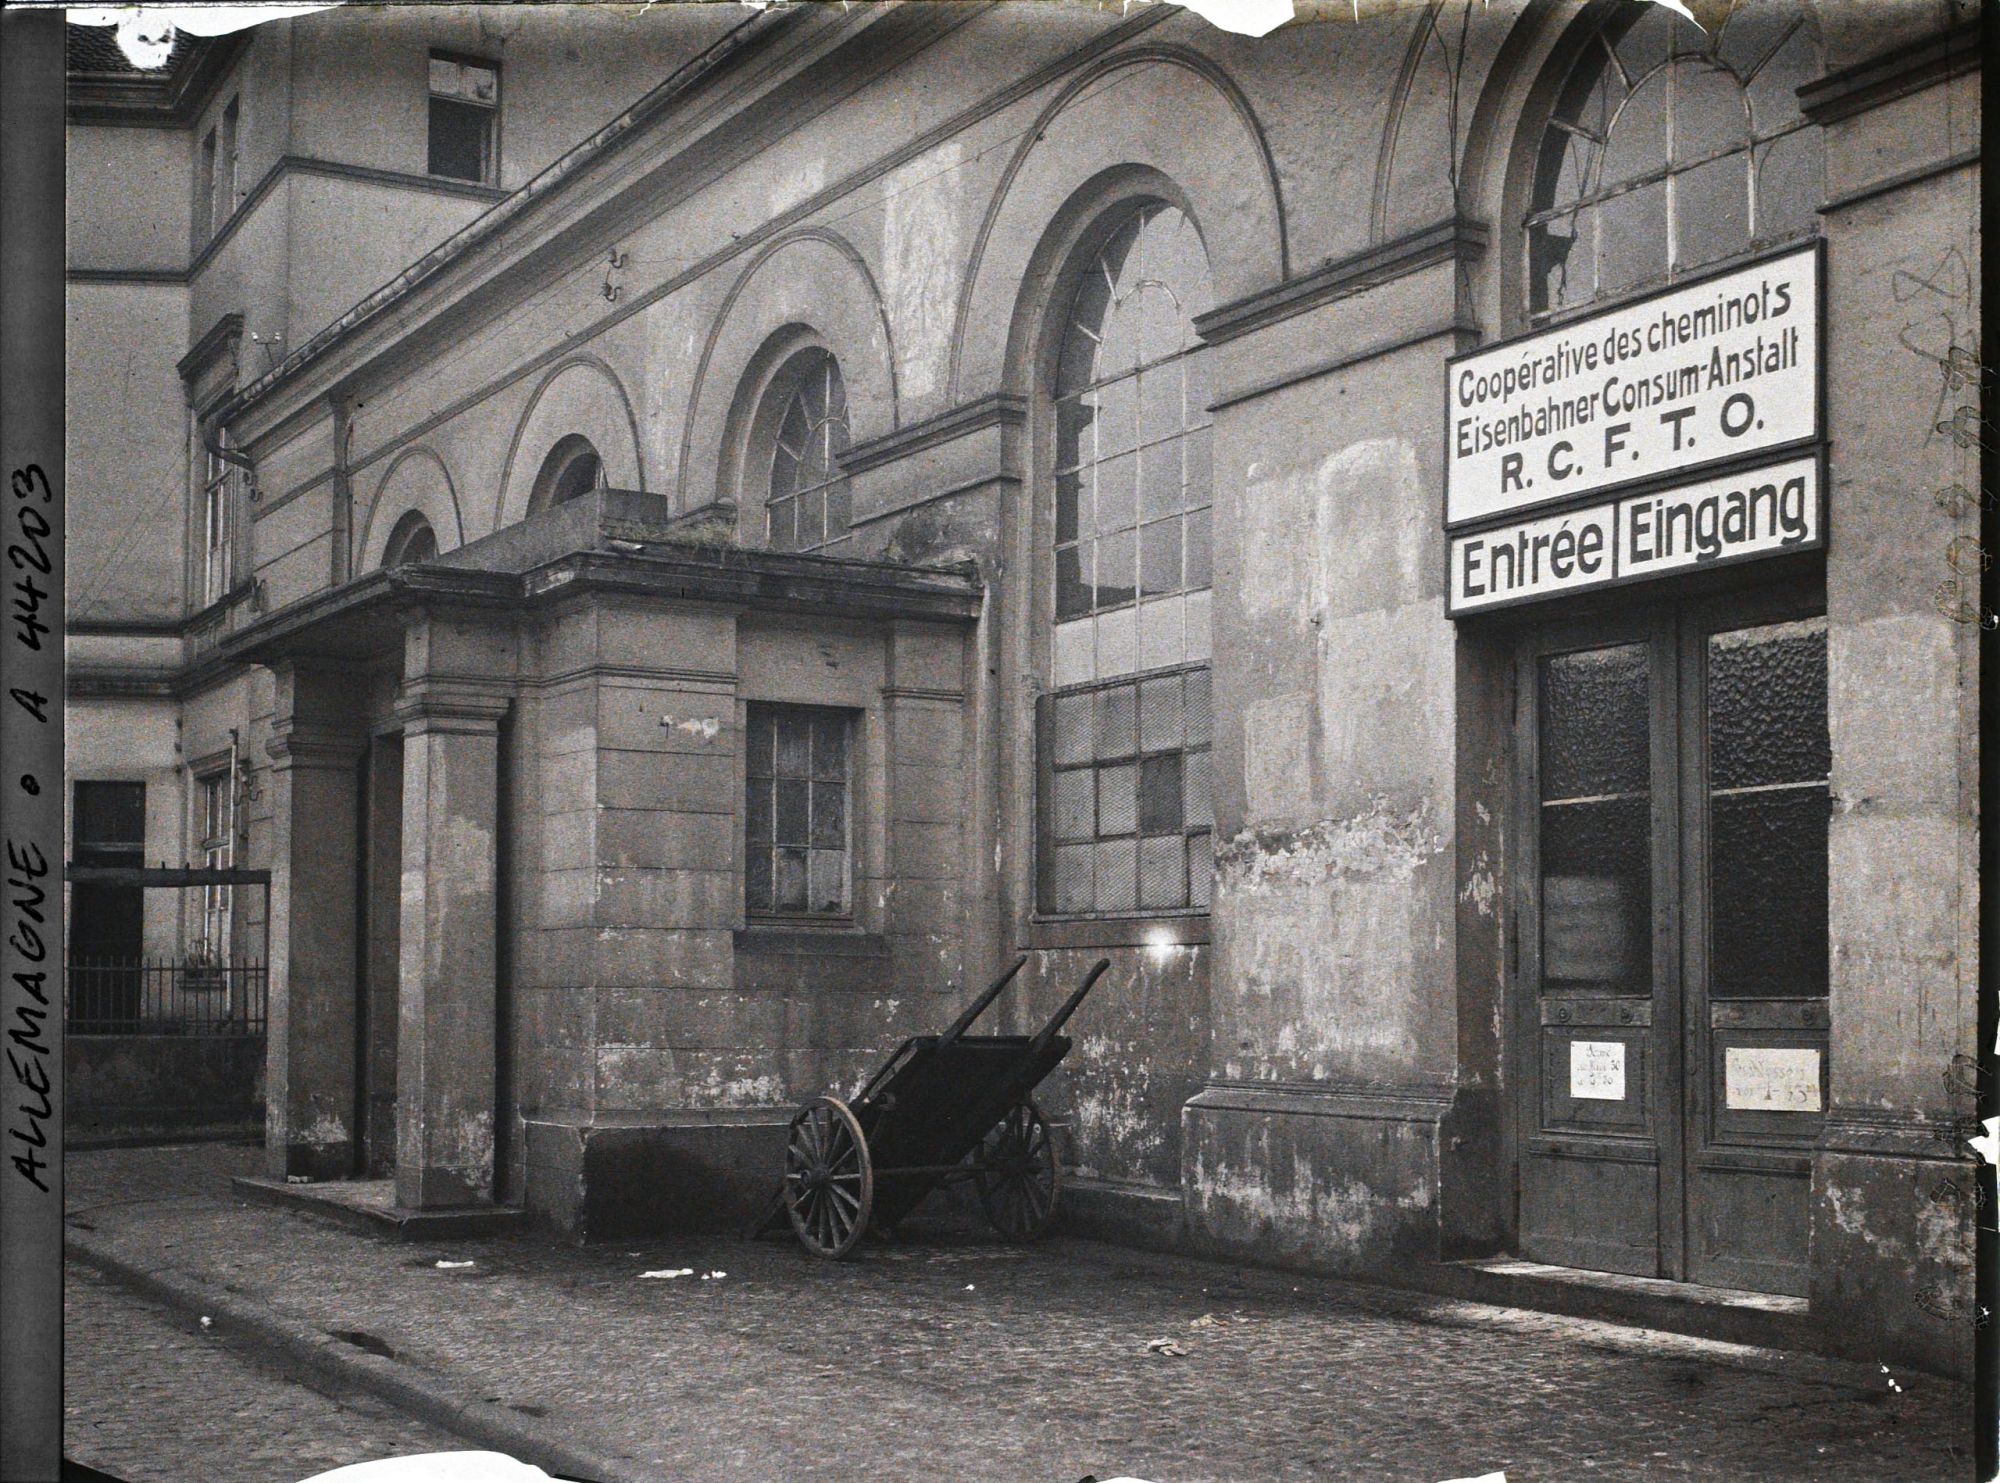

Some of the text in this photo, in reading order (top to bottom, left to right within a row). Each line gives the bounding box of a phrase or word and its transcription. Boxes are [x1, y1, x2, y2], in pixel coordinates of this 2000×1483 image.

[1459, 281, 1790, 407] Coopérative des cheminots
[1458, 393, 1599, 458] Eisenbahner
[1464, 520, 1603, 598] Entrée
[1630, 477, 1808, 562] Eingang
